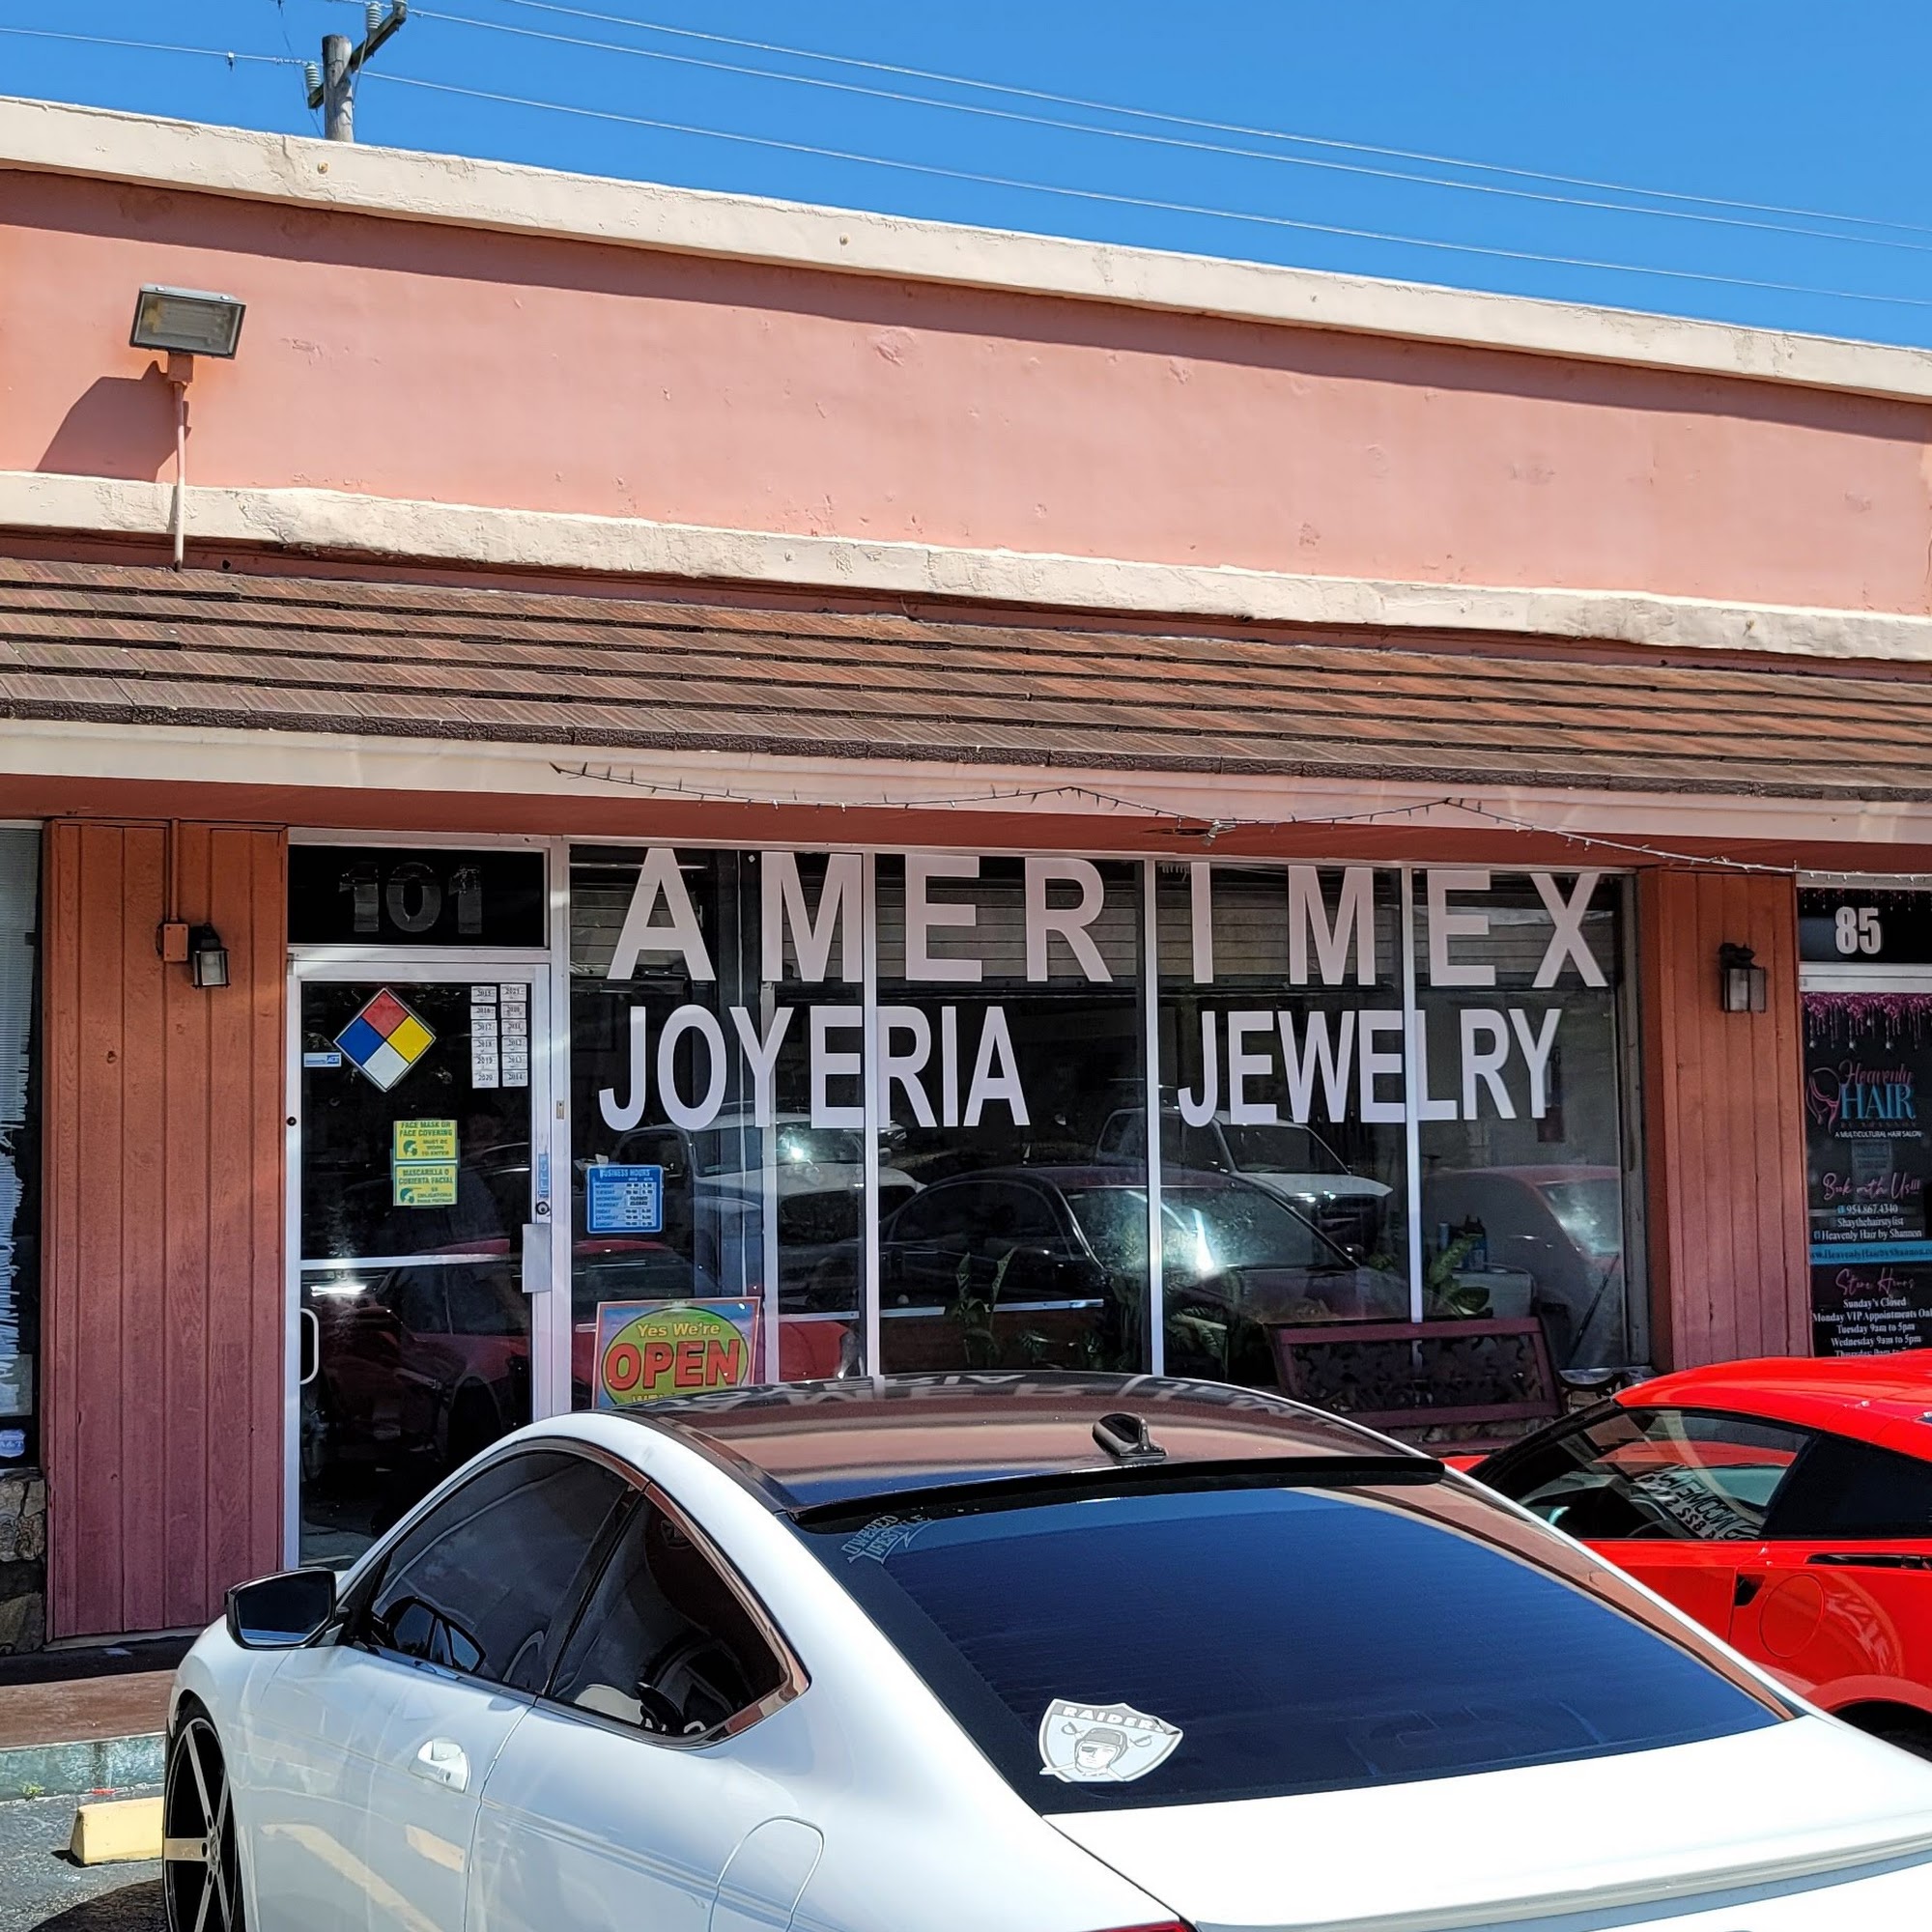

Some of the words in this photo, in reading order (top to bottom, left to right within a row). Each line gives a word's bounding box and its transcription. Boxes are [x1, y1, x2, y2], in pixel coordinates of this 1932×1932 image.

[338, 861, 483, 934] 101
[1834, 906, 1883, 954] 85
[598, 1004, 1031, 1132] JOYERIA
[1177, 1008, 1562, 1128] JEWELRY
[1838, 1059, 1914, 1084] Heavenly
[1839, 1082, 1917, 1120] HAIR
[1822, 1230, 1858, 1241] Heavenly
[1860, 1229, 1877, 1239] Hair
[1878, 1229, 1889, 1240] by
[1889, 1228, 1922, 1238] Shannon
[1843, 1297, 1879, 1309] Sunday's
[1880, 1296, 1907, 1307] Closed
[1812, 1312, 1844, 1323] Monday
[1846, 1311, 1862, 1321] VIP
[1863, 1309, 1918, 1322] Appointments
[1836, 1323, 1868, 1335] Tuesday
[1869, 1323, 1887, 1332] 9am
[1888, 1322, 1896, 1331] to
[1898, 1321, 1916, 1333] 5pm
[637, 1323, 668, 1338] Yes
[673, 1321, 721, 1336] We're
[1831, 1335, 1874, 1348] Wednesday
[1876, 1335, 1893, 1345] 9am
[1894, 1334, 1903, 1344] to
[1904, 1333, 1921, 1345] 5pm
[605, 1338, 741, 1391] OPEN
